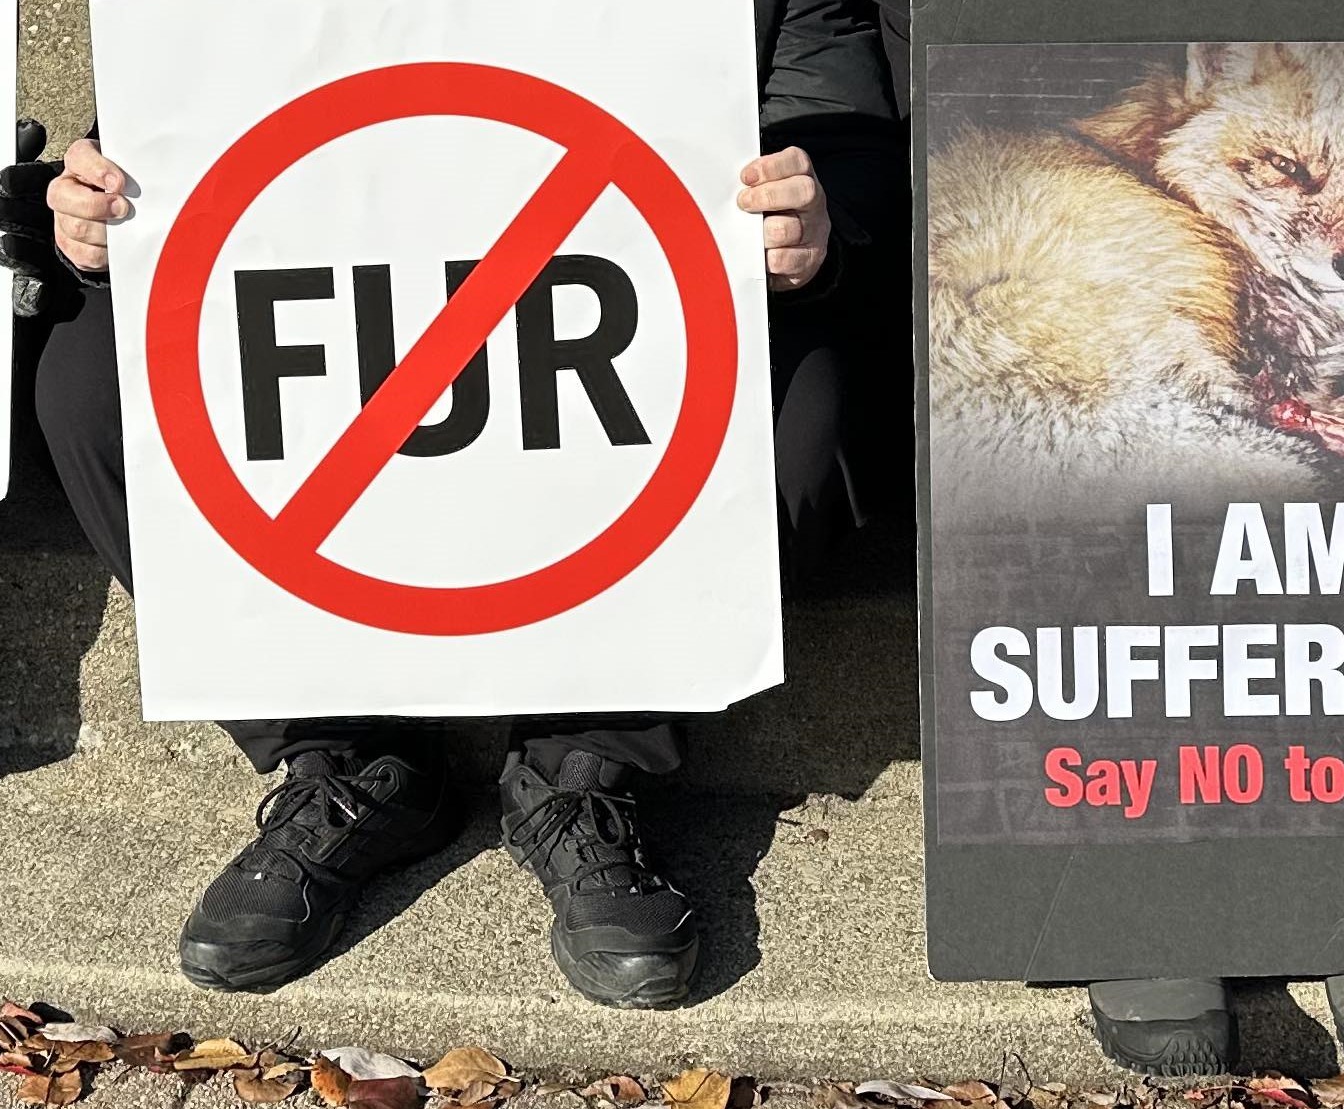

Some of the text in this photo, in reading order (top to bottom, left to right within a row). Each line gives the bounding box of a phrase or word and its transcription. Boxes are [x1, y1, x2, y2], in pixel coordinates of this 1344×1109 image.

[234, 254, 653, 462] FUR
[1146, 503, 1174, 597] I
[1044, 746, 1158, 819] Say
[1178, 745, 1265, 805] NO
